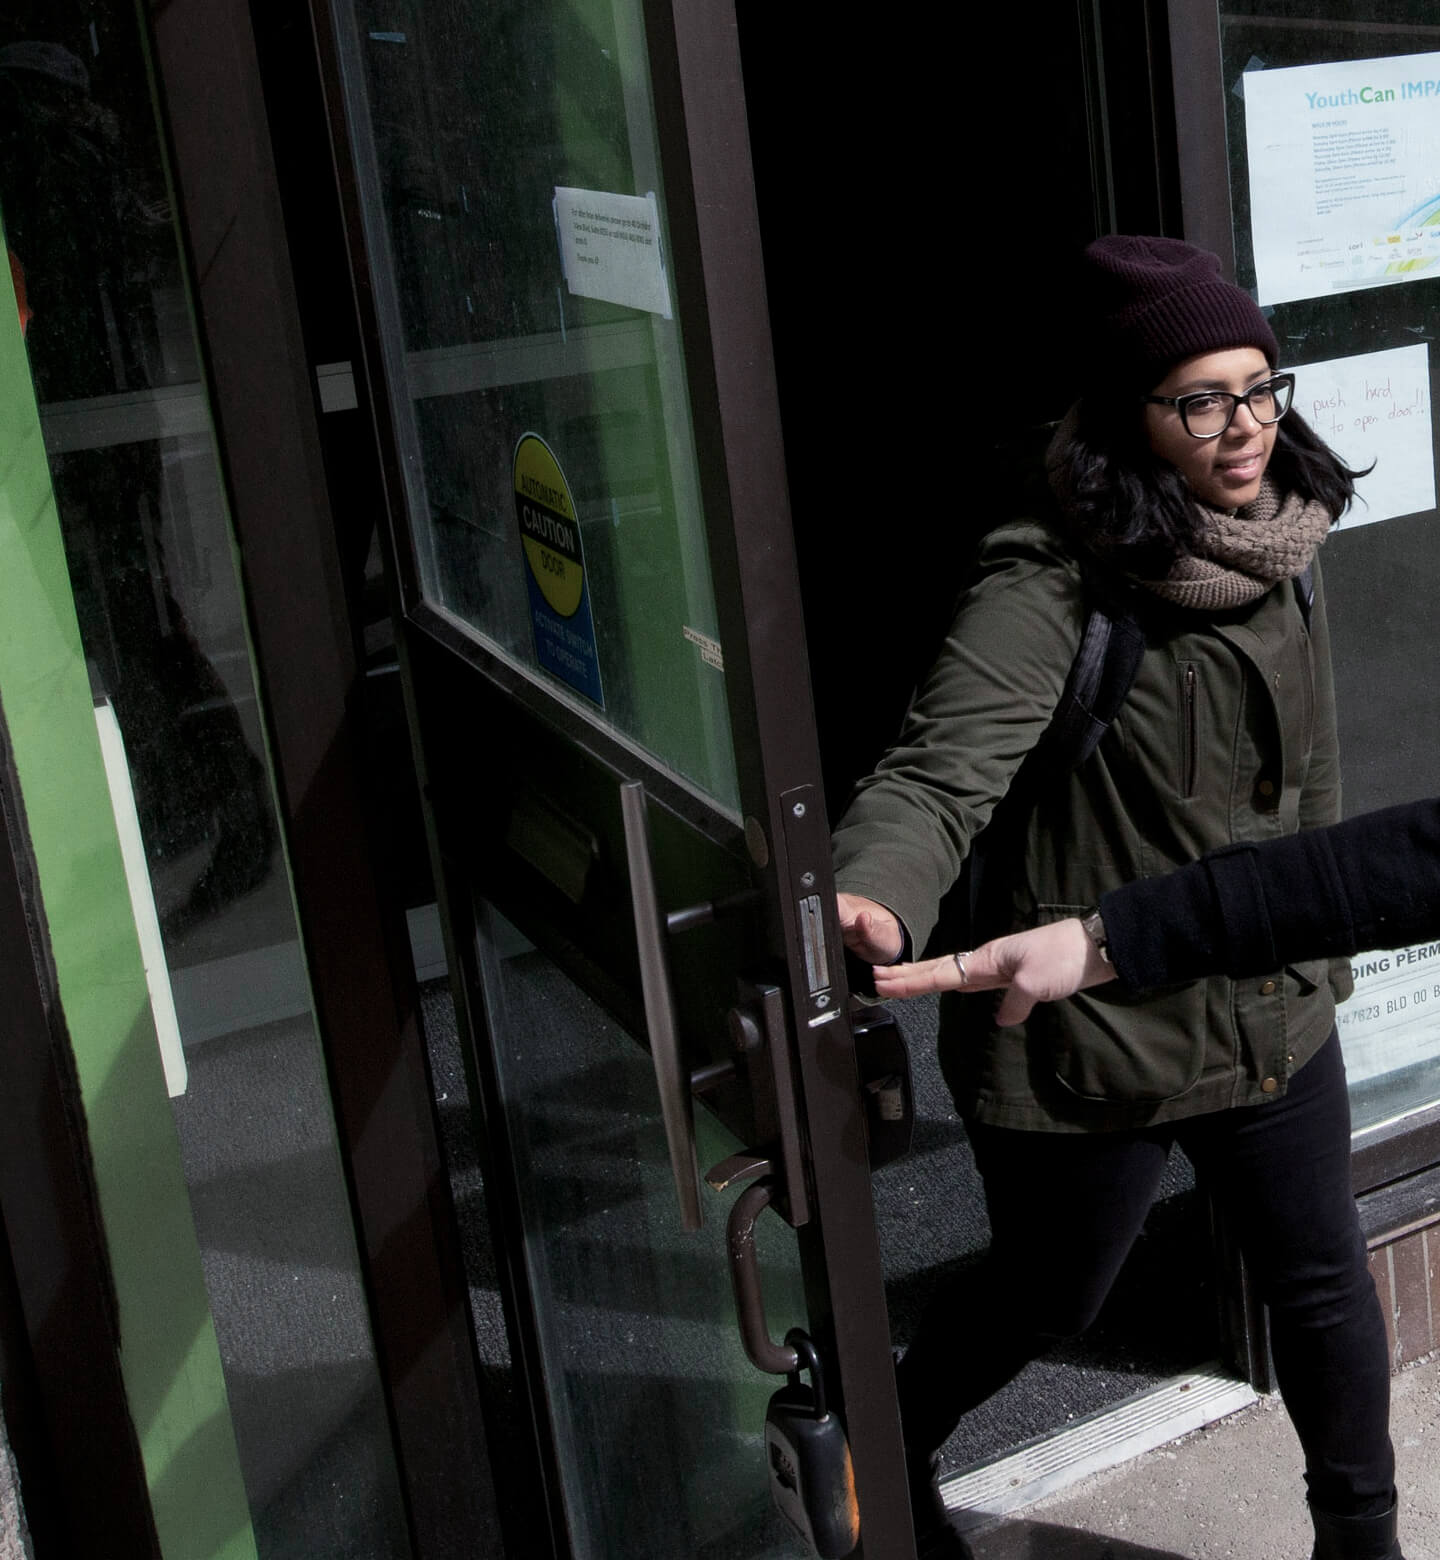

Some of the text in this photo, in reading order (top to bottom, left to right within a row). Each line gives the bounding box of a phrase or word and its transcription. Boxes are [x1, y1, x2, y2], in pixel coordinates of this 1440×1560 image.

[1304, 86, 1395, 109] YouthCan
[1313, 388, 1346, 420] push
[1353, 416, 1379, 432] open
[521, 474, 567, 514] AUTOMATIC
[522, 504, 576, 553] CAUTION
[540, 550, 566, 580] DOOR
[1352, 958, 1391, 981] DING
[1386, 996, 1407, 1014] BLD
